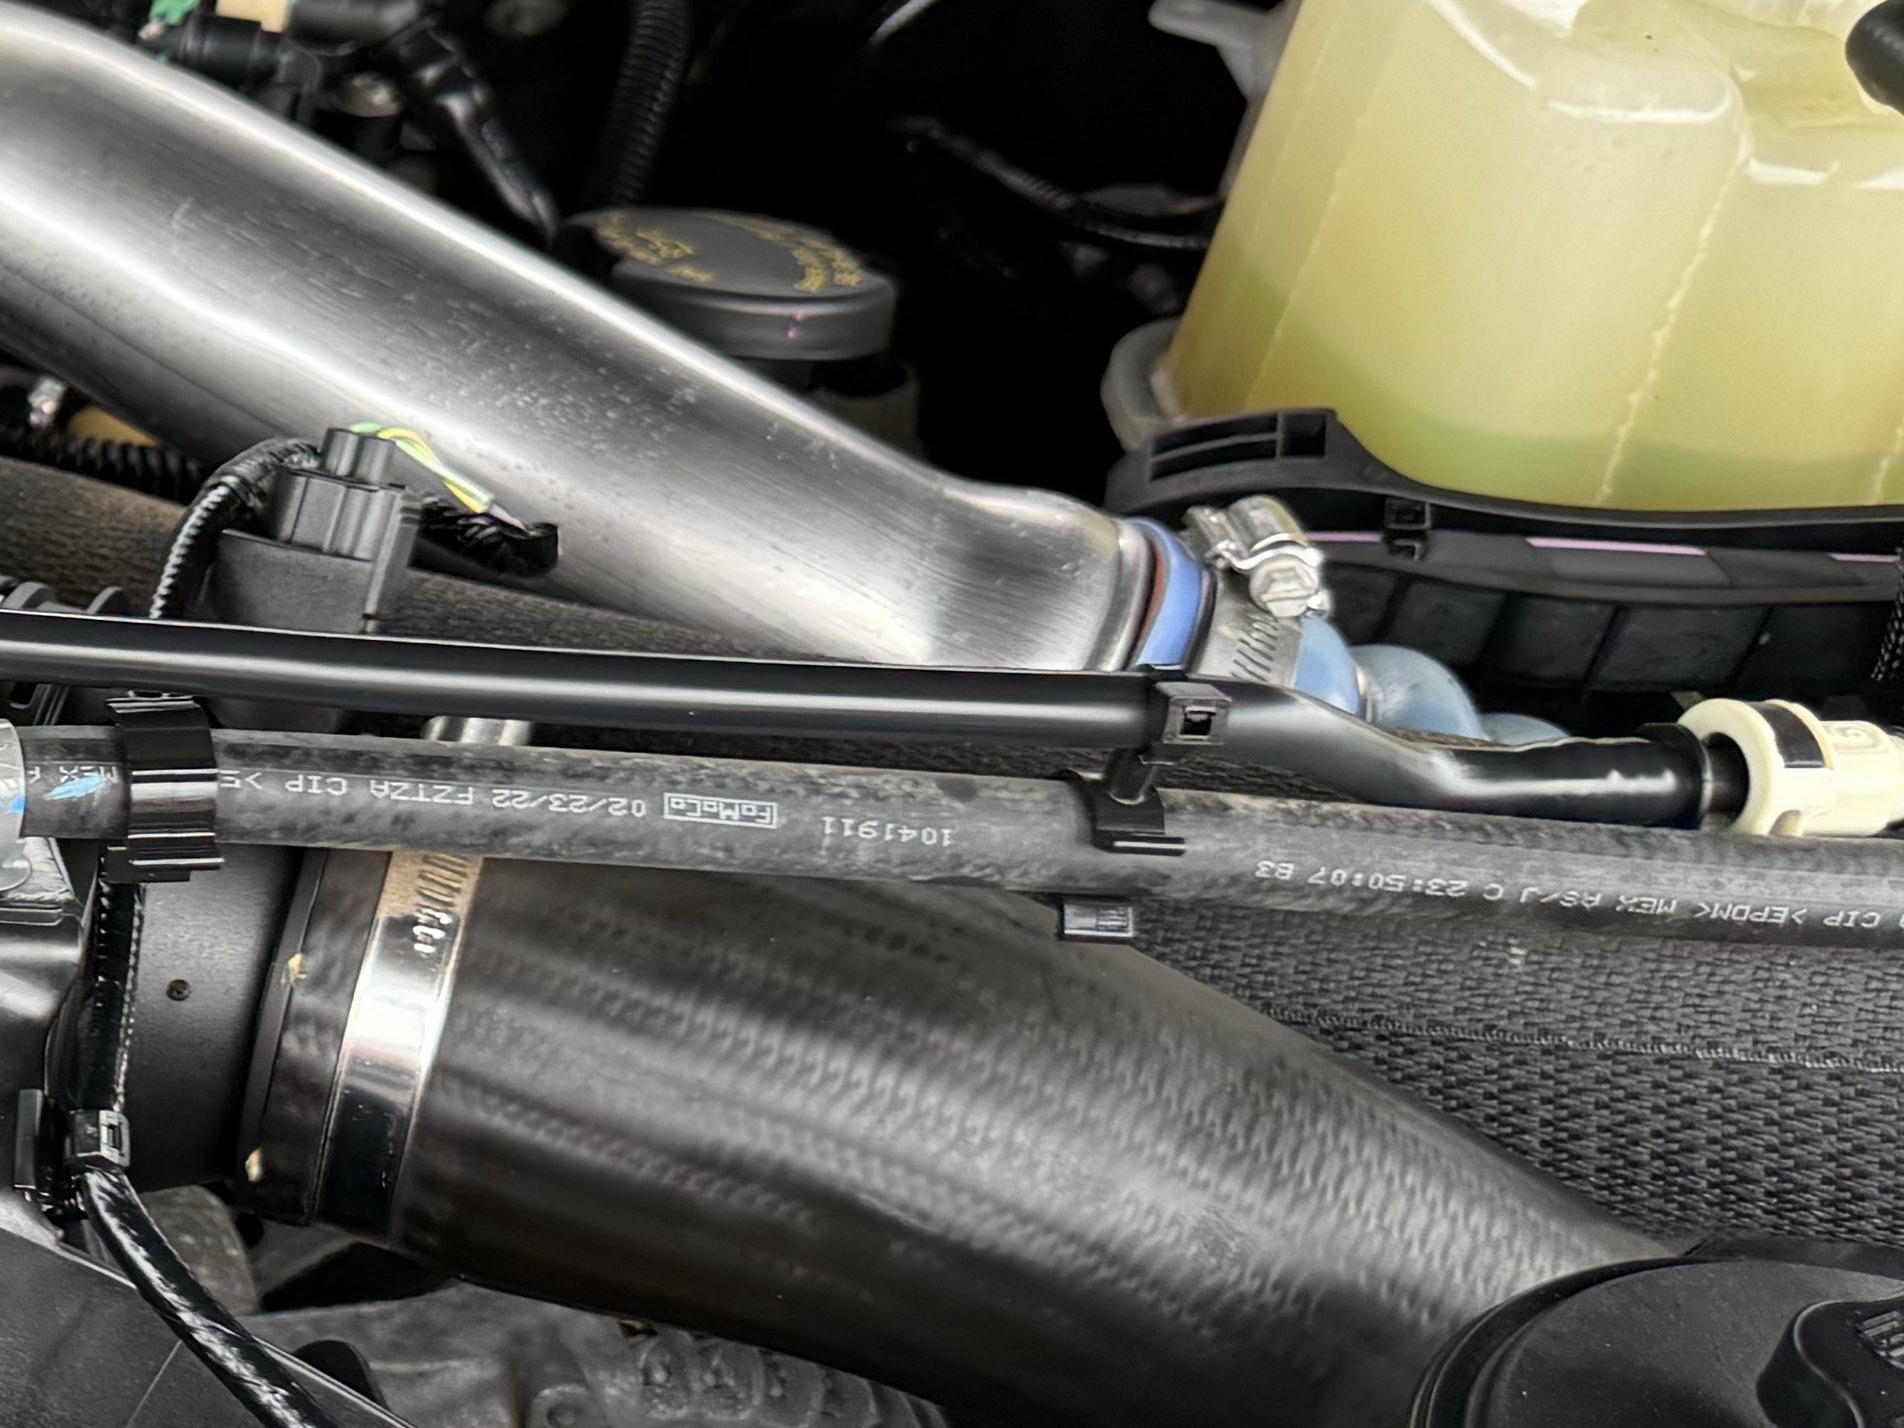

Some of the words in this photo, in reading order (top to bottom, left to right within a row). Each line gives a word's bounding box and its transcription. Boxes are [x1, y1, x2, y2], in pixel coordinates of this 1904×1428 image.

[284, 772, 348, 796] CIP
[369, 778, 474, 806] FZTZA
[491, 788, 647, 818] 02/23/22
[669, 795, 773, 825] FoMoCo
[821, 815, 955, 847] 1041911
[1253, 859, 1295, 881] B3
[1307, 865, 1469, 898] 23:50:07
[1481, 882, 1506, 902] C
[1519, 886, 1603, 913] AS/J
[1615, 894, 1679, 915] MEX
[1693, 900, 1808, 925] >EPDM<
[1822, 909, 1882, 929] CIP
